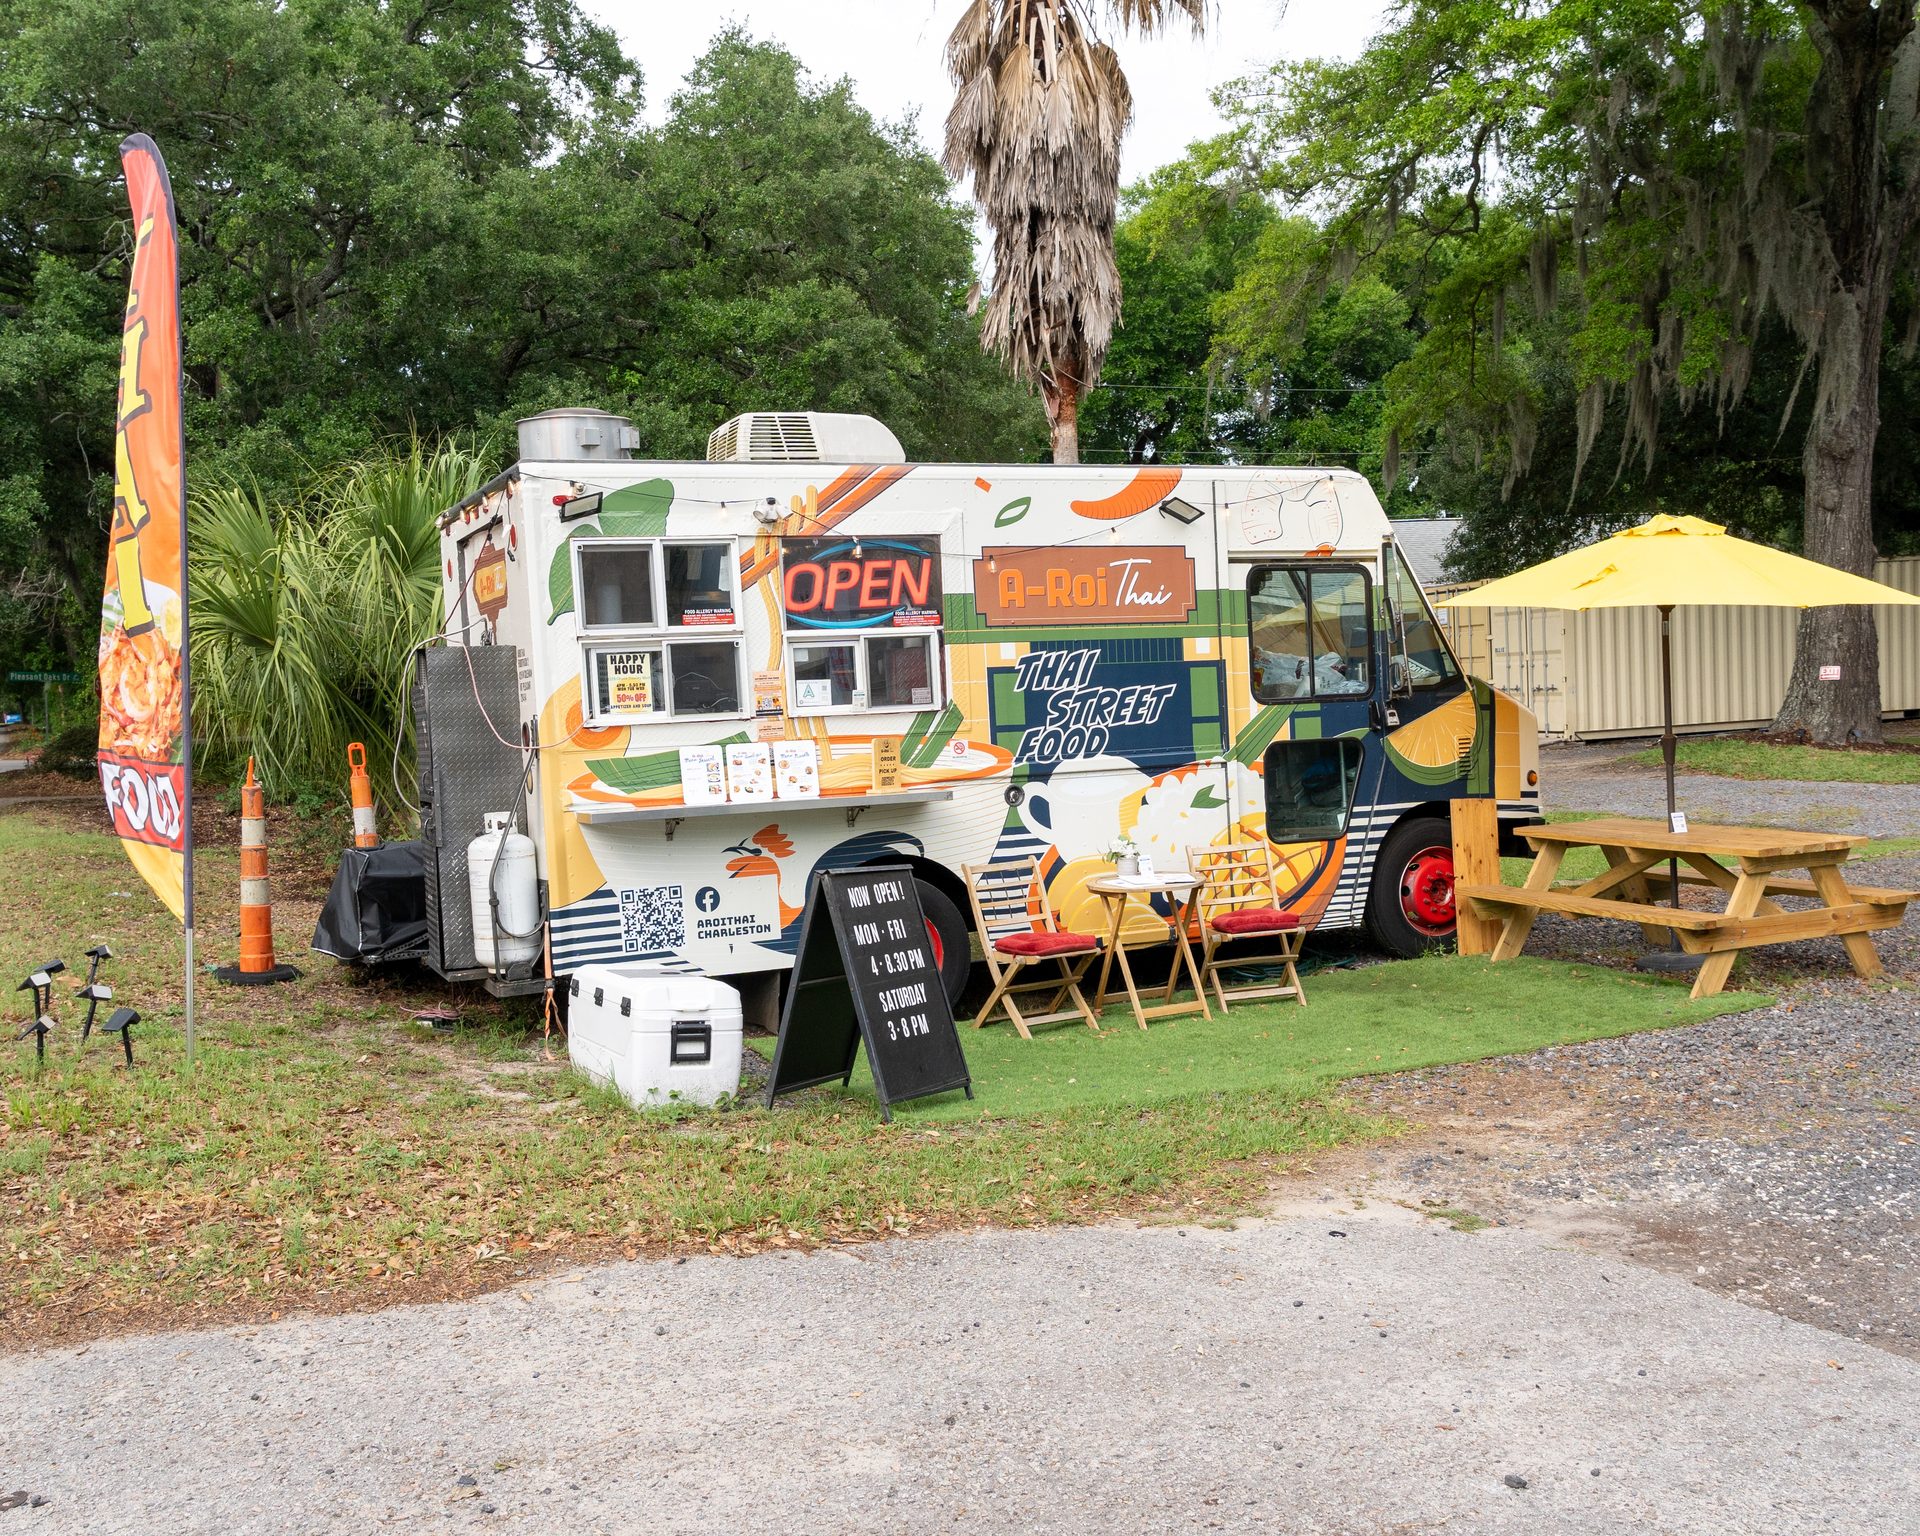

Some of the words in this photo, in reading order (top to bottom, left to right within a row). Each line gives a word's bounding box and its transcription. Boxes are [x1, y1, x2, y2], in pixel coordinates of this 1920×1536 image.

[784, 558, 932, 613] OPEN
[999, 567, 1108, 608] A-Roi
[1109, 558, 1173, 607] Thai
[610, 654, 646, 665] HAPPY
[614, 664, 643, 675] HOUR
[1013, 648, 1101, 692] THAI
[10, 673, 42, 681] Pleasant
[44, 673, 60, 681] Oaks
[616, 694, 634, 703] 50%
[634, 693, 647, 702] OFF
[803, 683, 815, 698] A
[1046, 683, 1177, 729] STREET
[1011, 725, 1110, 767] FOOD
[847, 885, 871, 908] NOW
[697, 914, 756, 929] AROITHAI
[697, 924, 771, 939] CHARLESTON
[853, 922, 880, 946] MON
[886, 918, 907, 941] FRI
[907, 948, 926, 970] PM
[878, 982, 927, 1013] SATURDAY
[910, 1013, 930, 1036] PM
